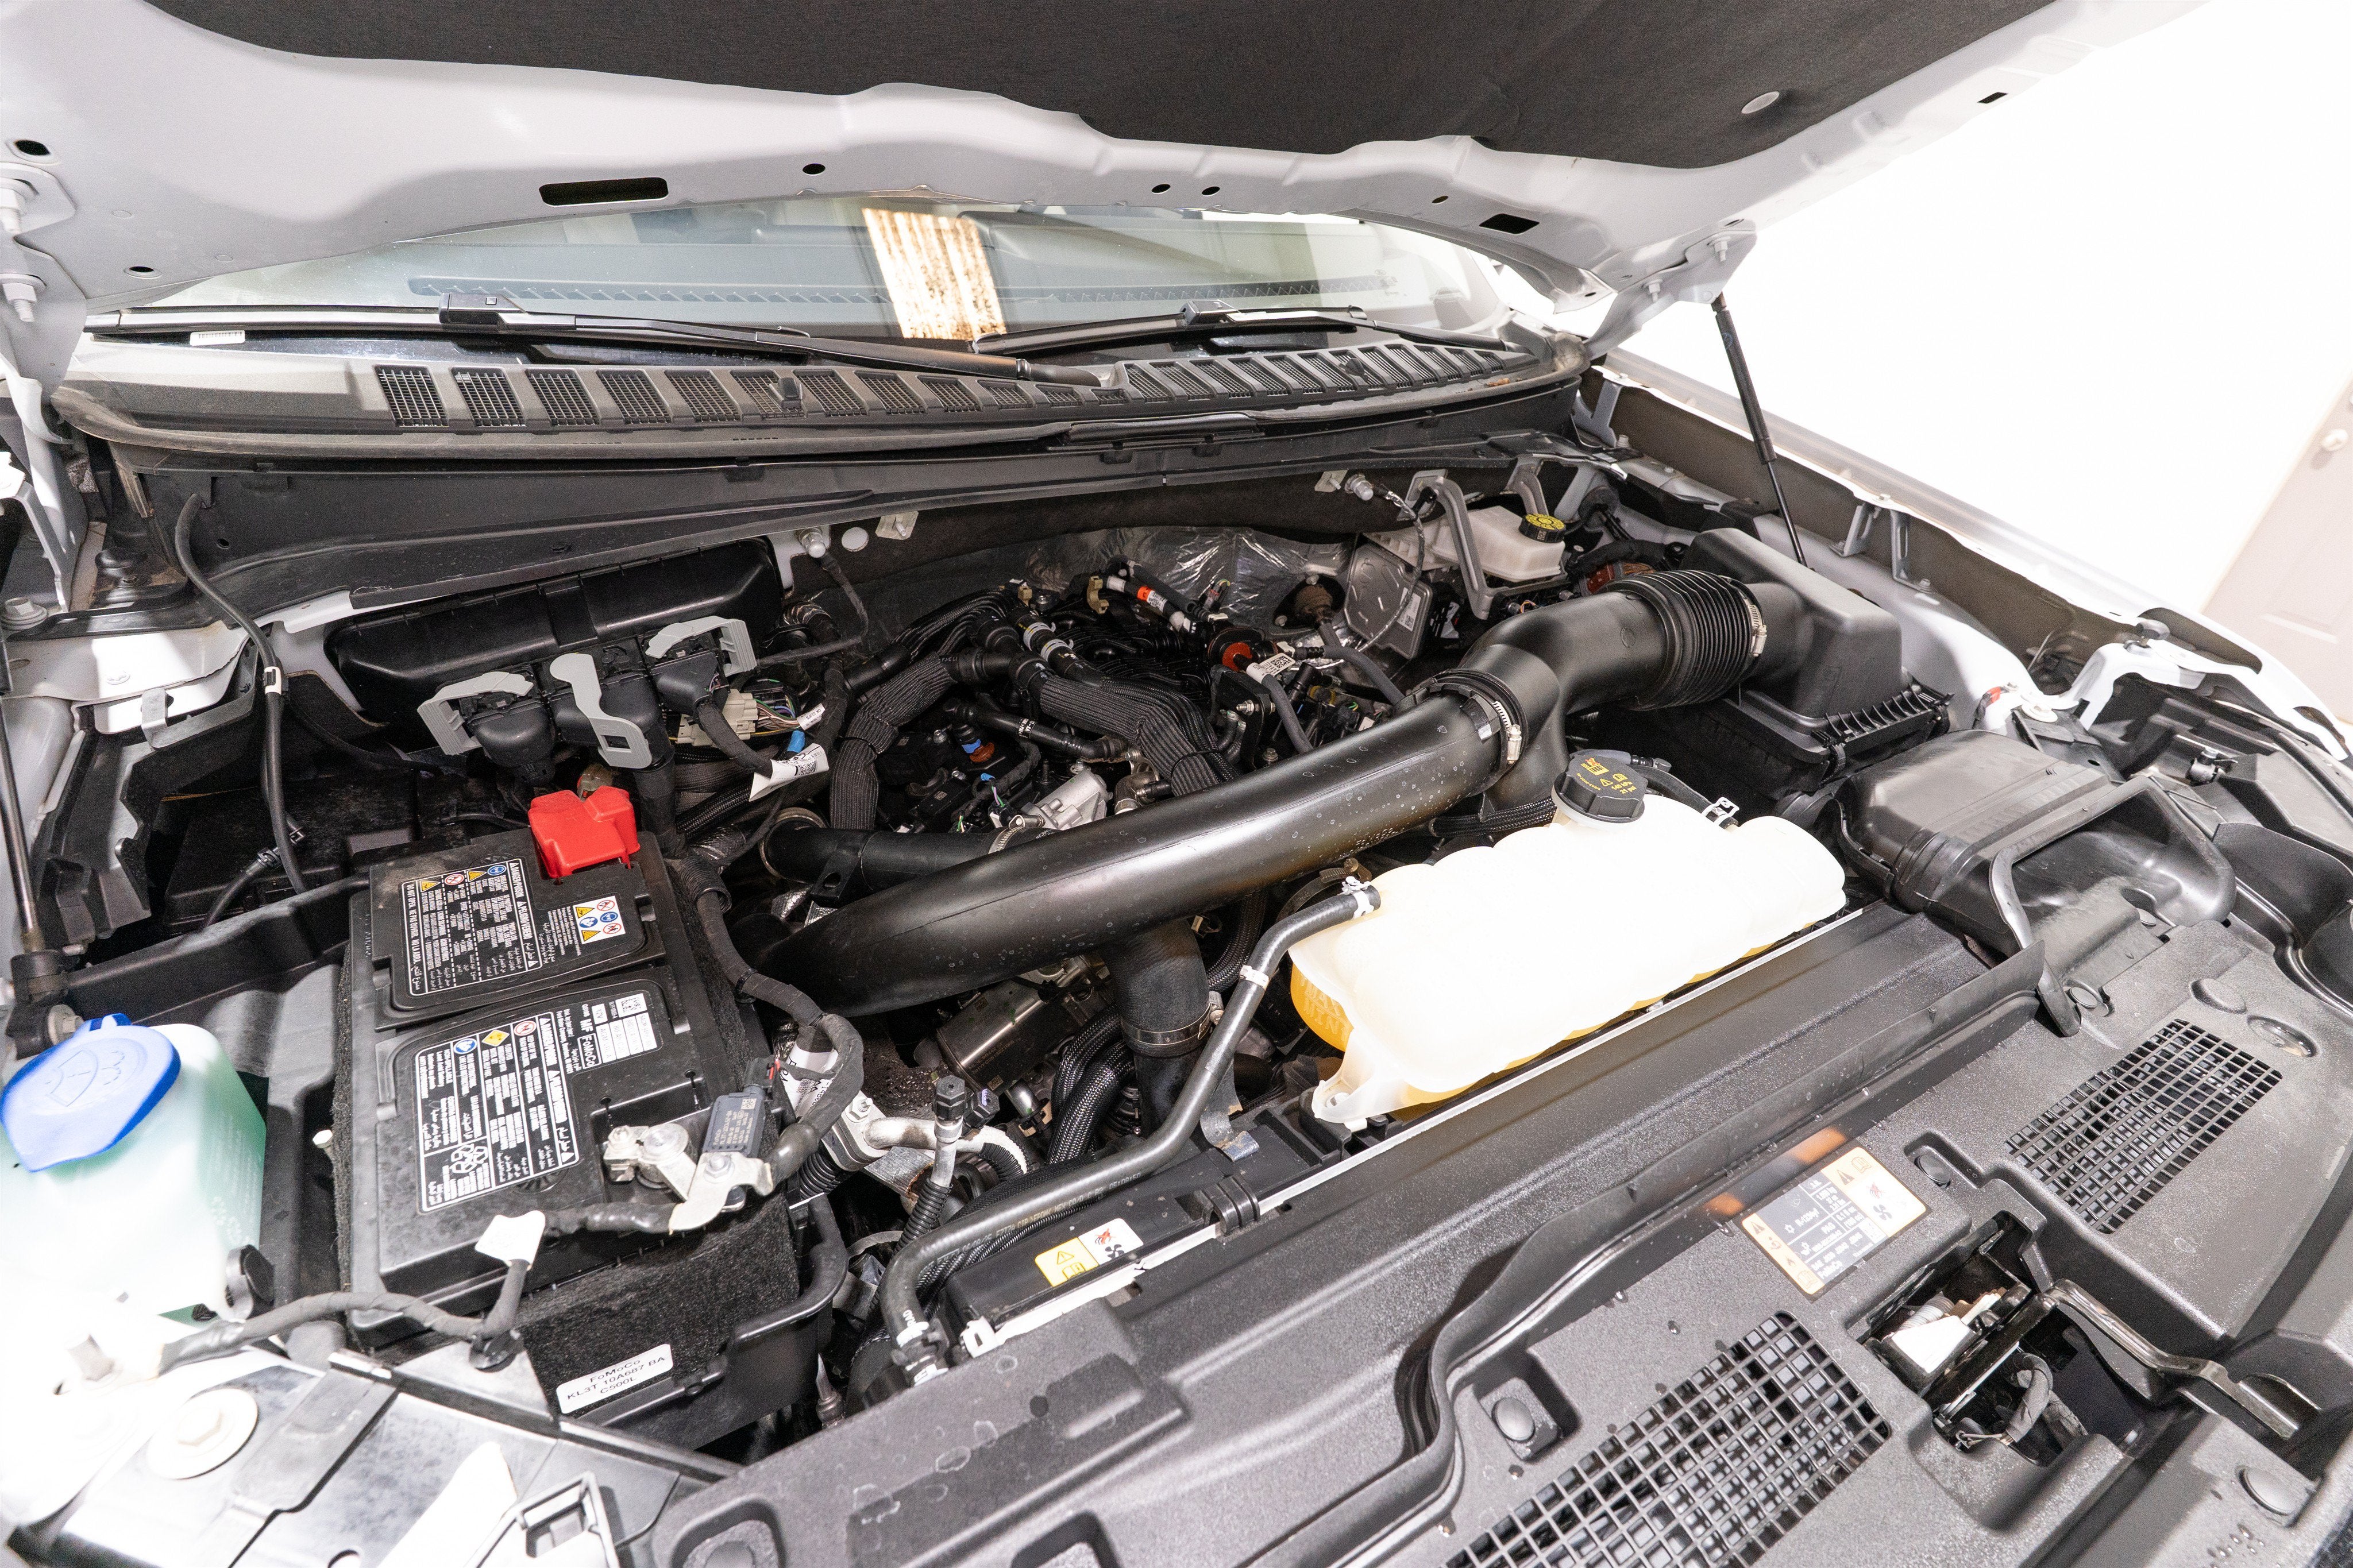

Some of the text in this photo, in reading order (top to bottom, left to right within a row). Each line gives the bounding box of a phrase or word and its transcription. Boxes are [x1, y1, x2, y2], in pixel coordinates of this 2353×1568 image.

[510, 867, 524, 897] DANGER/POISON
[410, 922, 418, 939] OUVRIR.
[518, 906, 533, 939] PELIGRO/VENENO
[412, 951, 421, 964] ABRA.
[580, 1019, 593, 1032] MF
[595, 1009, 603, 1019] 12V
[541, 1024, 557, 1066] DANGER/POISON
[580, 1035, 597, 1067] FoMoCo
[444, 1049, 452, 1083] NON-SPILLABLE
[567, 1357, 665, 1400] KL3T 10A687 BA
[589, 1360, 641, 1382] FoMoCo
[600, 1377, 637, 1394] C500L
